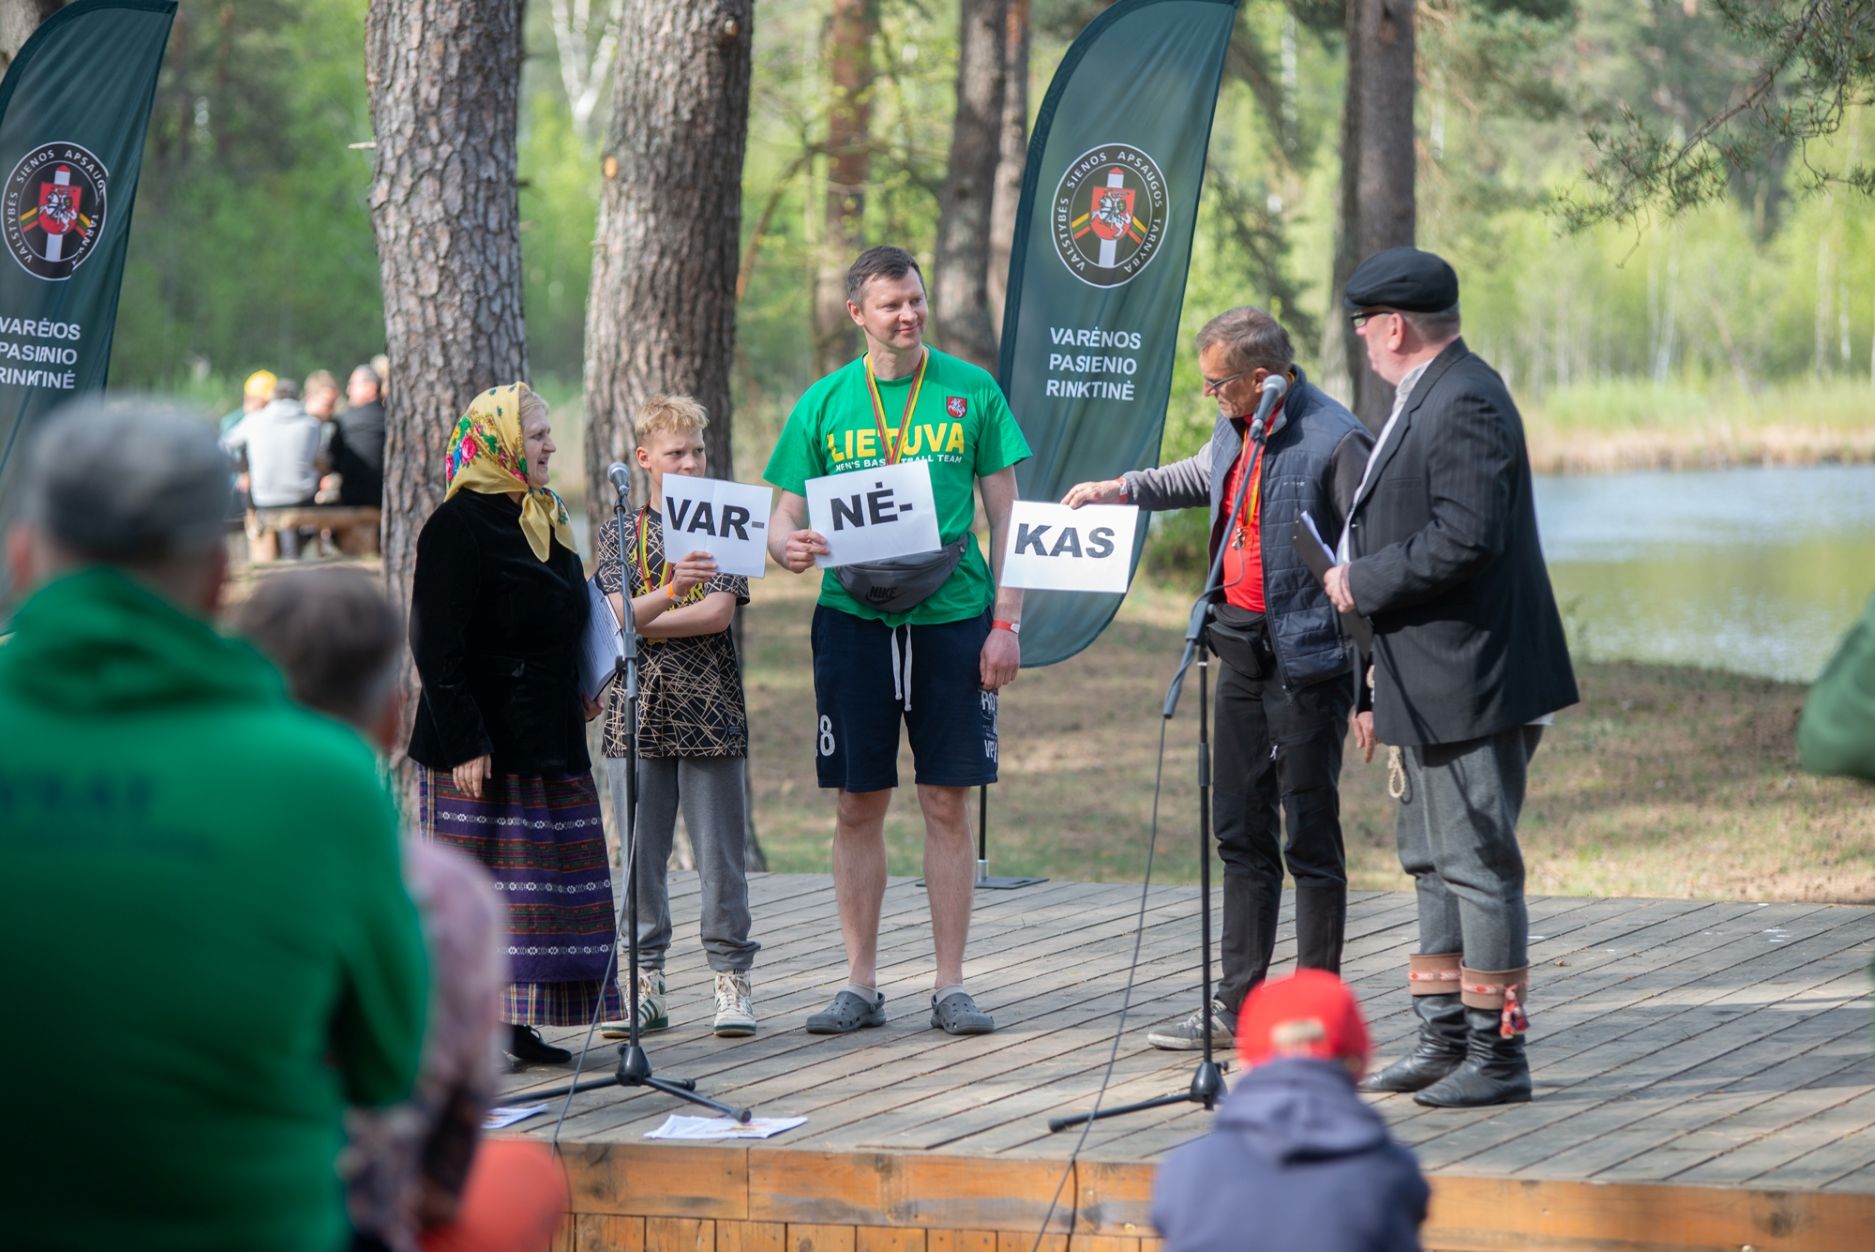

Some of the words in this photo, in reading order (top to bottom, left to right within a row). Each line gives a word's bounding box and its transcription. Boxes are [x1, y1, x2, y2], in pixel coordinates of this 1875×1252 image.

[16, 149, 55, 183] SIENOS
[1066, 151, 1107, 189] SIENOS
[1117, 151, 1163, 208] APSAUGOS
[8, 192, 33, 263] VALSTYBĖS
[1057, 198, 1086, 271] VALSTYBĖS
[1123, 217, 1161, 273] TARNYBA
[0, 316, 81, 341] VARĖOS
[1050, 326, 1142, 350] VARĖNOS
[1049, 353, 1138, 375] PASIENIO
[1046, 379, 1135, 401] RINKTINĖ
[937, 454, 963, 464] TEAM
[666, 496, 765, 541] VAR-
[831, 481, 913, 531] NĖ-
[1014, 523, 1115, 559] KAS
[870, 586, 898, 599] NIKE
